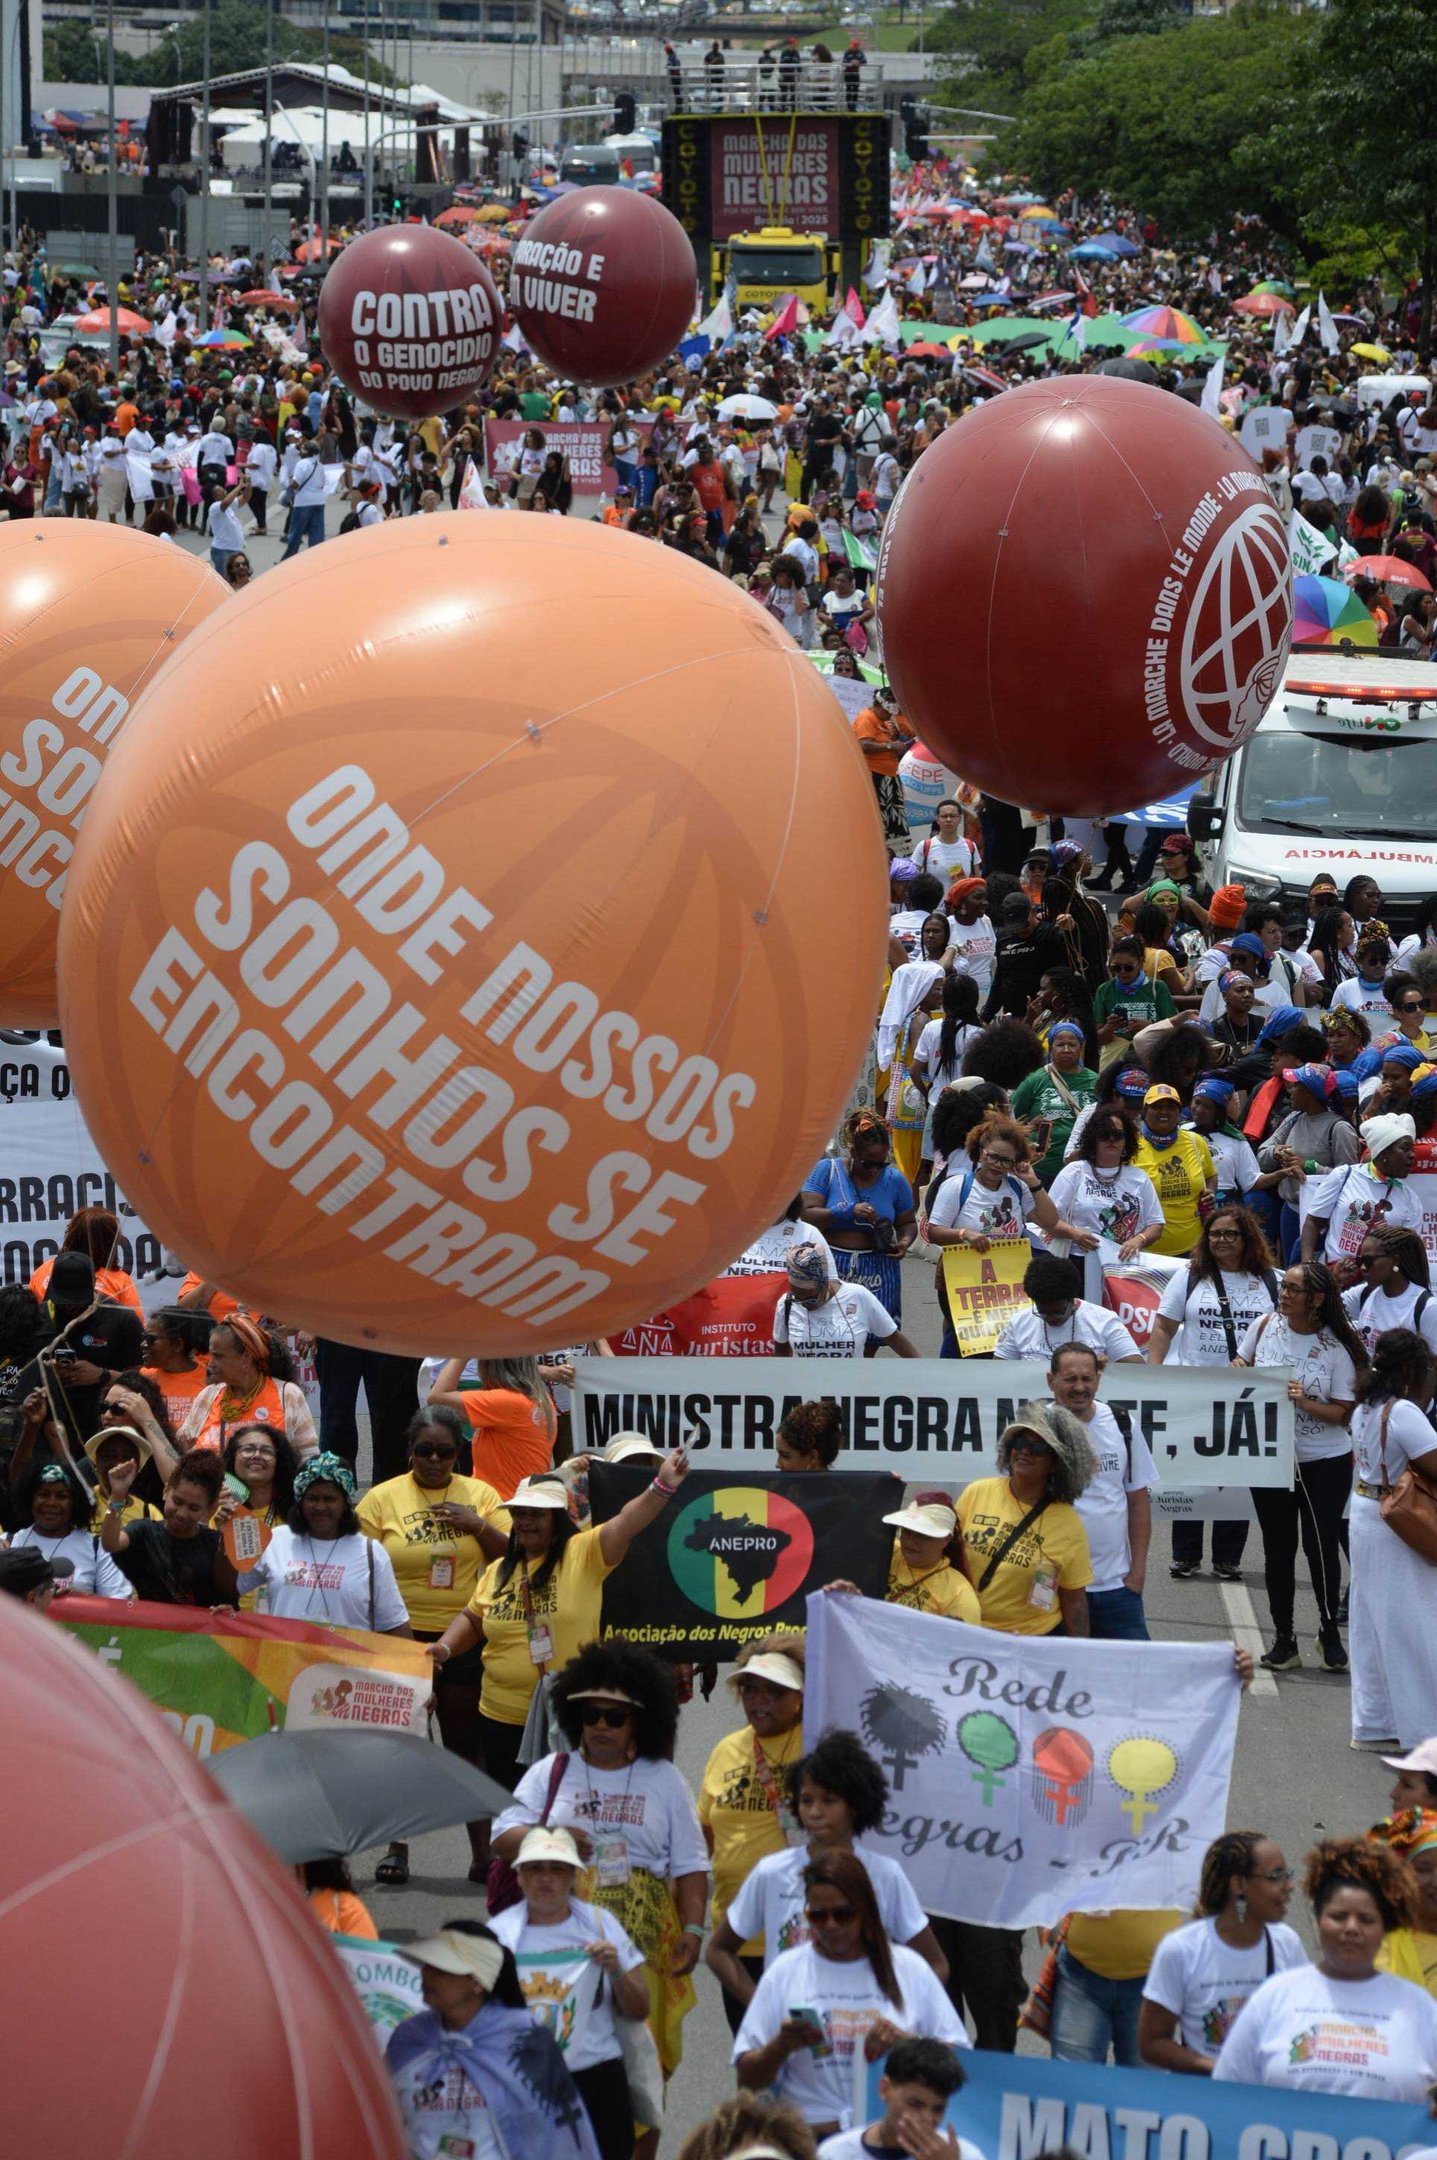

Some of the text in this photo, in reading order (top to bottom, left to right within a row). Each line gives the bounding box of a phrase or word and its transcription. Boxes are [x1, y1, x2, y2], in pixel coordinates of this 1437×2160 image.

[723, 134, 828, 151] MARCHA DAS
[723, 153, 828, 174] MULHERES
[723, 176, 828, 205] NEGRAS
[587, 253, 605, 281] E
[351, 283, 493, 338] CONTRA
[524, 275, 598, 323] VIVER
[354, 340, 370, 366] O
[358, 364, 484, 391] DO POVO NEGRO
[1182, 491, 1223, 553] MONDE
[1170, 548, 1194, 577] LE
[1150, 577, 1183, 632] DANS
[1144, 638, 1169, 721] MARCHE
[286, 763, 756, 1160] ONDE NOSSOS
[193, 840, 707, 1267] SONHOS SE
[129, 925, 611, 1326] ENCONTRAM
[1161, 1189, 1191, 1198] NEGRAS
[981, 1259, 997, 1283] A
[955, 1283, 1030, 1310] TERRA
[702, 1323, 756, 1335] INSTITUTO
[682, 1336, 775, 1357] Juristas
[794, 1341, 855, 1350] MULHER
[1194, 1387, 1279, 1457] JÁ!
[1156, 1496, 1194, 1504] Juristas
[1159, 1504, 1193, 1513] Negras
[709, 1537, 777, 1552] ANEPRO
[306, 1579, 341, 1590] NEGRAS
[604, 1623, 687, 1645] Associação
[689, 1626, 717, 1641] dos
[718, 1623, 773, 1641] Negros
[355, 1681, 415, 1699] MARCHA DAS
[942, 1656, 1094, 1719] Rede
[353, 1692, 413, 1711] MULHERES
[351, 1704, 410, 1727] NEGRAS
[601, 1811, 644, 1826] NEGRAS
[1317, 2050, 1368, 2066] NEGRAS
